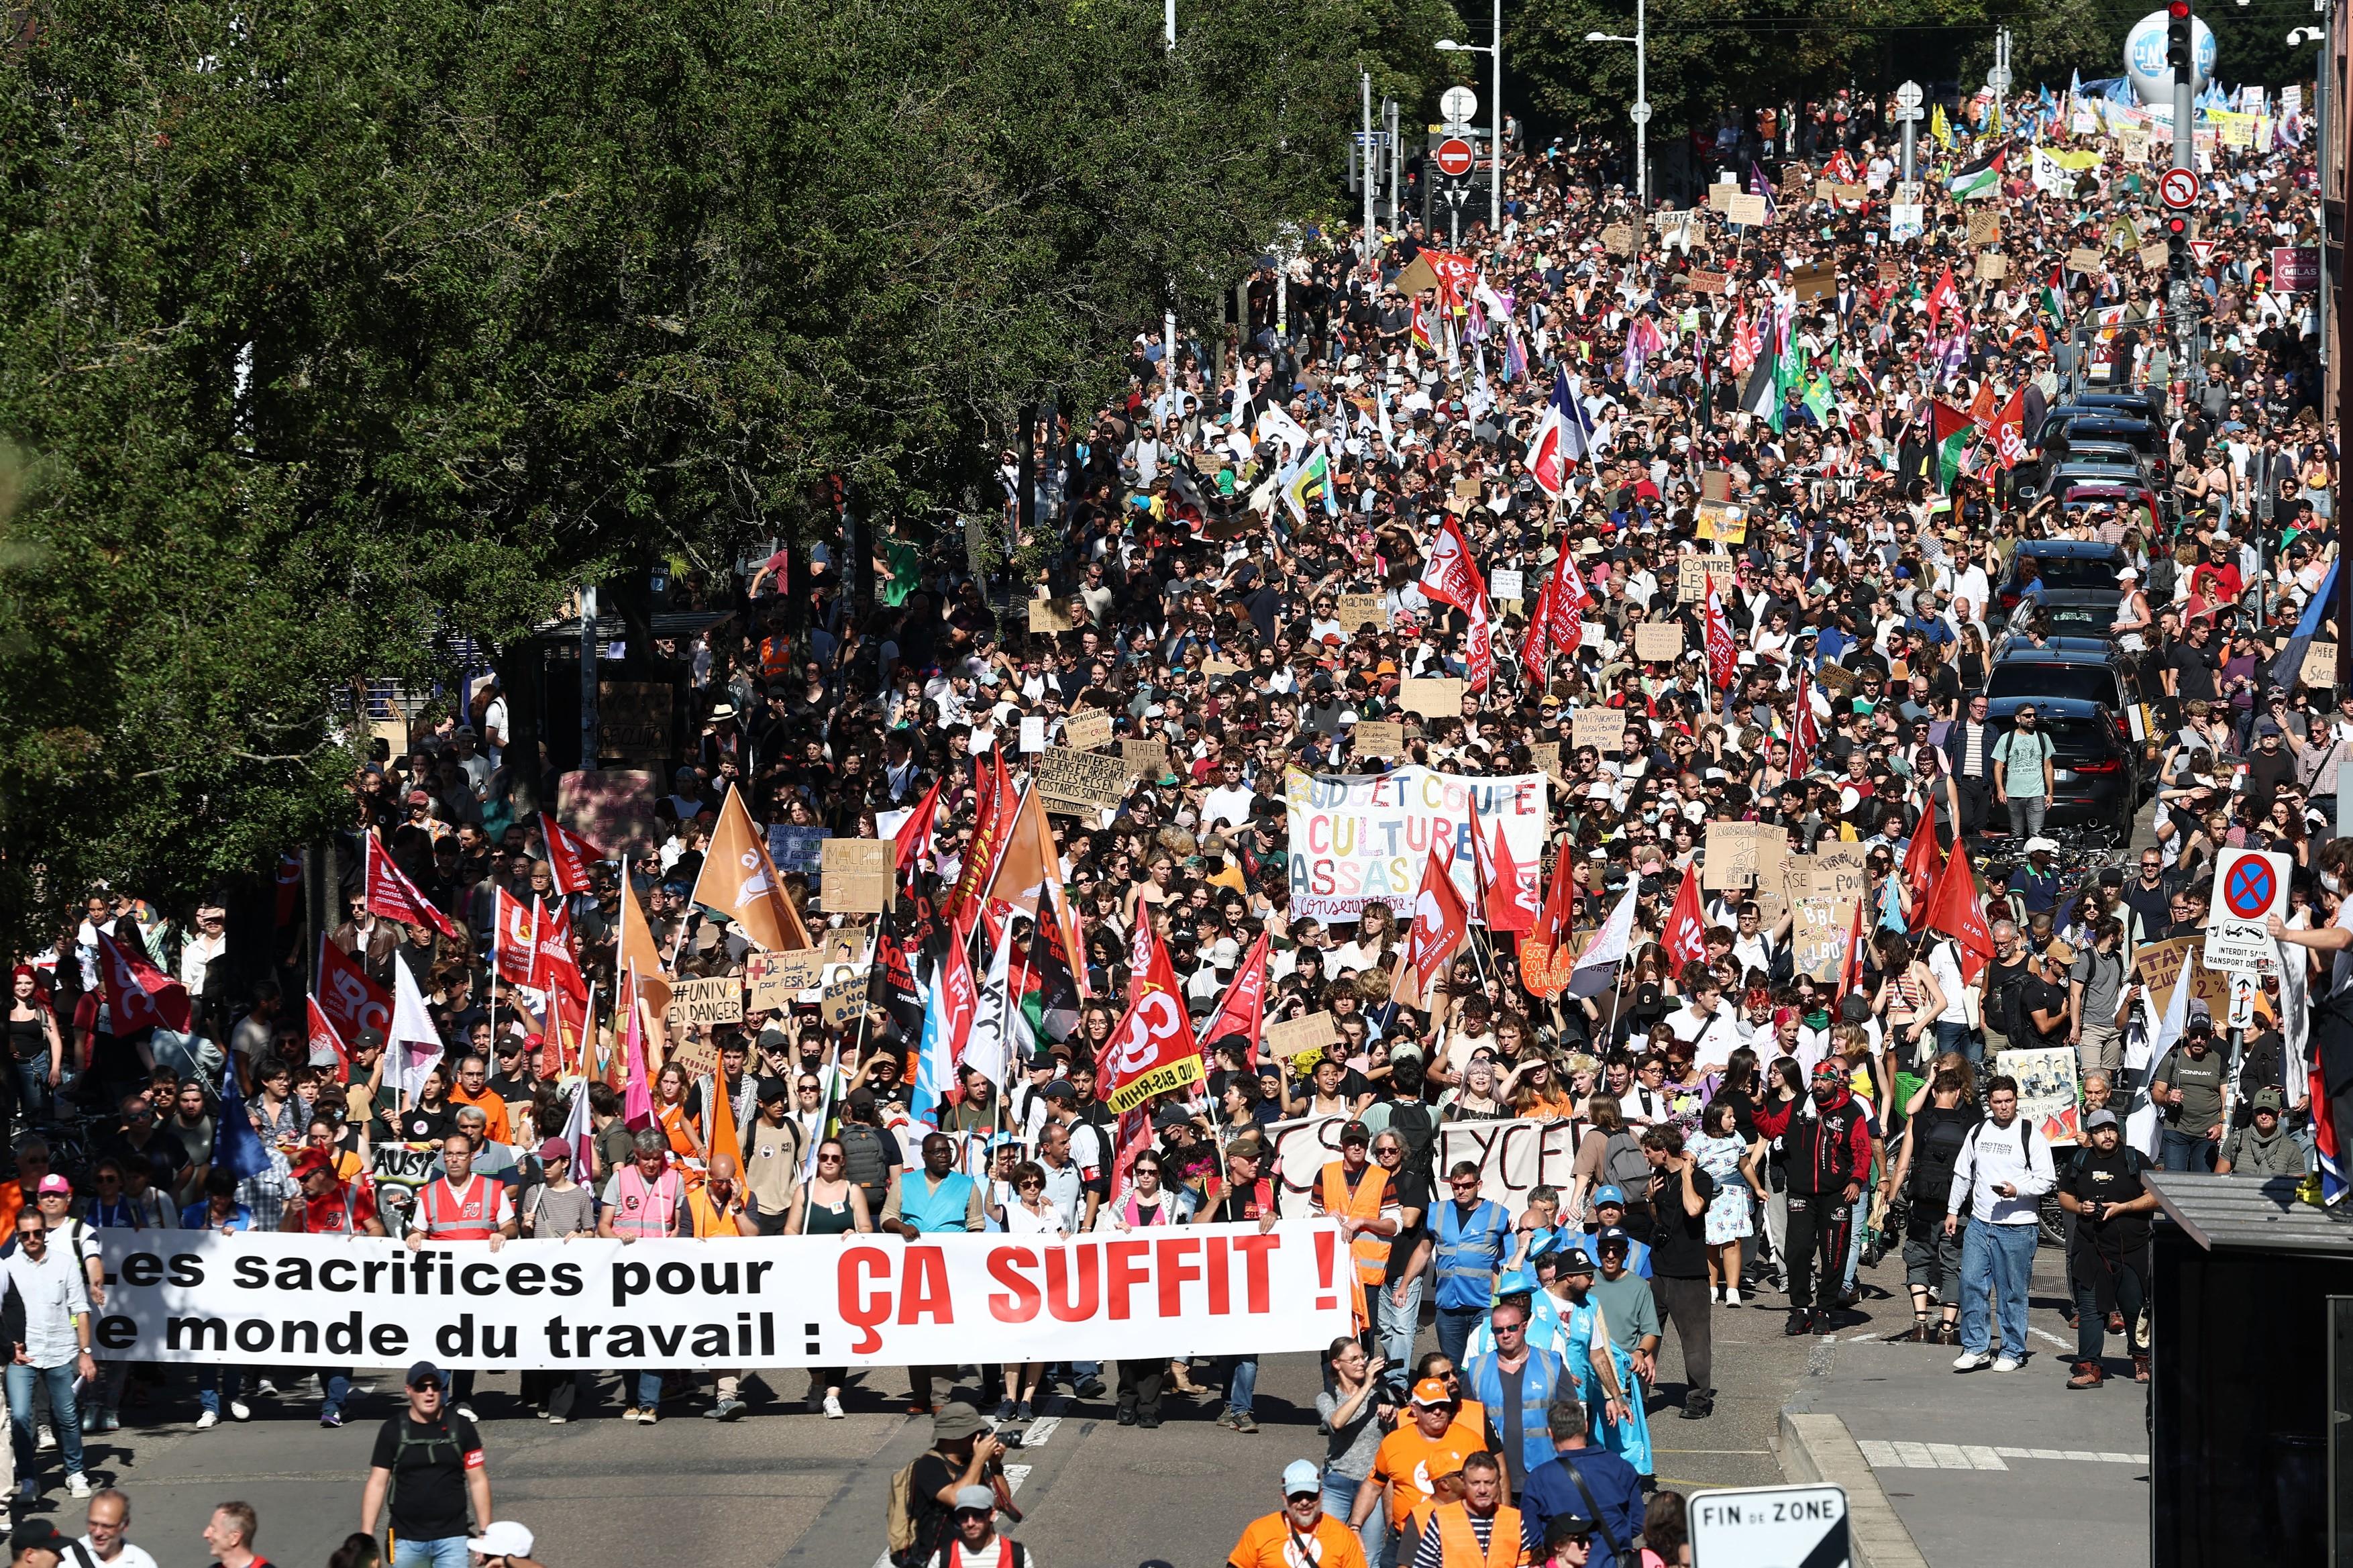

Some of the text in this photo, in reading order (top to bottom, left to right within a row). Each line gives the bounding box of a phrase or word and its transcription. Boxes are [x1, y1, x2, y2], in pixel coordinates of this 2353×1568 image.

[2285, 251, 2317, 261] SNACK
[1973, 415, 1992, 427] JUSTICE
[1682, 559, 1730, 571] CONTRE
[1681, 573, 1704, 589] LES
[1822, 664, 1857, 684] REDISTRIB
[1067, 709, 1106, 726] RETAILLEAU
[1577, 714, 1587, 723] MA
[1581, 725, 1597, 733] AUSSI
[1045, 747, 1069, 761] DEVIL
[1131, 742, 1162, 757] HATER
[1042, 757, 1075, 772] ITICIENS
[1076, 764, 1087, 774] ET
[1154, 761, 1163, 770] DE
[1038, 779, 1121, 804] COSTARDS SONT TOUS
[1080, 775, 1103, 789] MECS
[1103, 780, 1114, 792] EN
[1308, 814, 1474, 862] CULTURE
[826, 846, 891, 866] MACRON
[377, 880, 397, 890] union
[1803, 906, 1837, 927] BBL
[2218, 947, 2246, 957] INTERDIT
[766, 959, 808, 976] De budget
[2206, 955, 2244, 967] TRANSPORT
[673, 981, 728, 1002] #UNIV
[760, 980, 778, 996] pour
[2196, 980, 2213, 999] 2
[846, 992, 866, 1004] NO
[669, 1002, 741, 1025] EN DANGER
[679, 1056, 717, 1074] ETUDIAN
[2044, 1110, 2062, 1120] BOUT
[1980, 1141, 2013, 1149] MOTION
[232, 1250, 584, 1296] sacrifices
[612, 1261, 774, 1307] pour
[837, 1231, 1337, 1354] ÇA SUFFIT !
[95, 1315, 138, 1350] e
[166, 1310, 409, 1356] monde
[436, 1313, 517, 1358] du
[545, 1312, 775, 1358] travail
[1703, 1500, 1834, 1526] FIN DE ZONE
